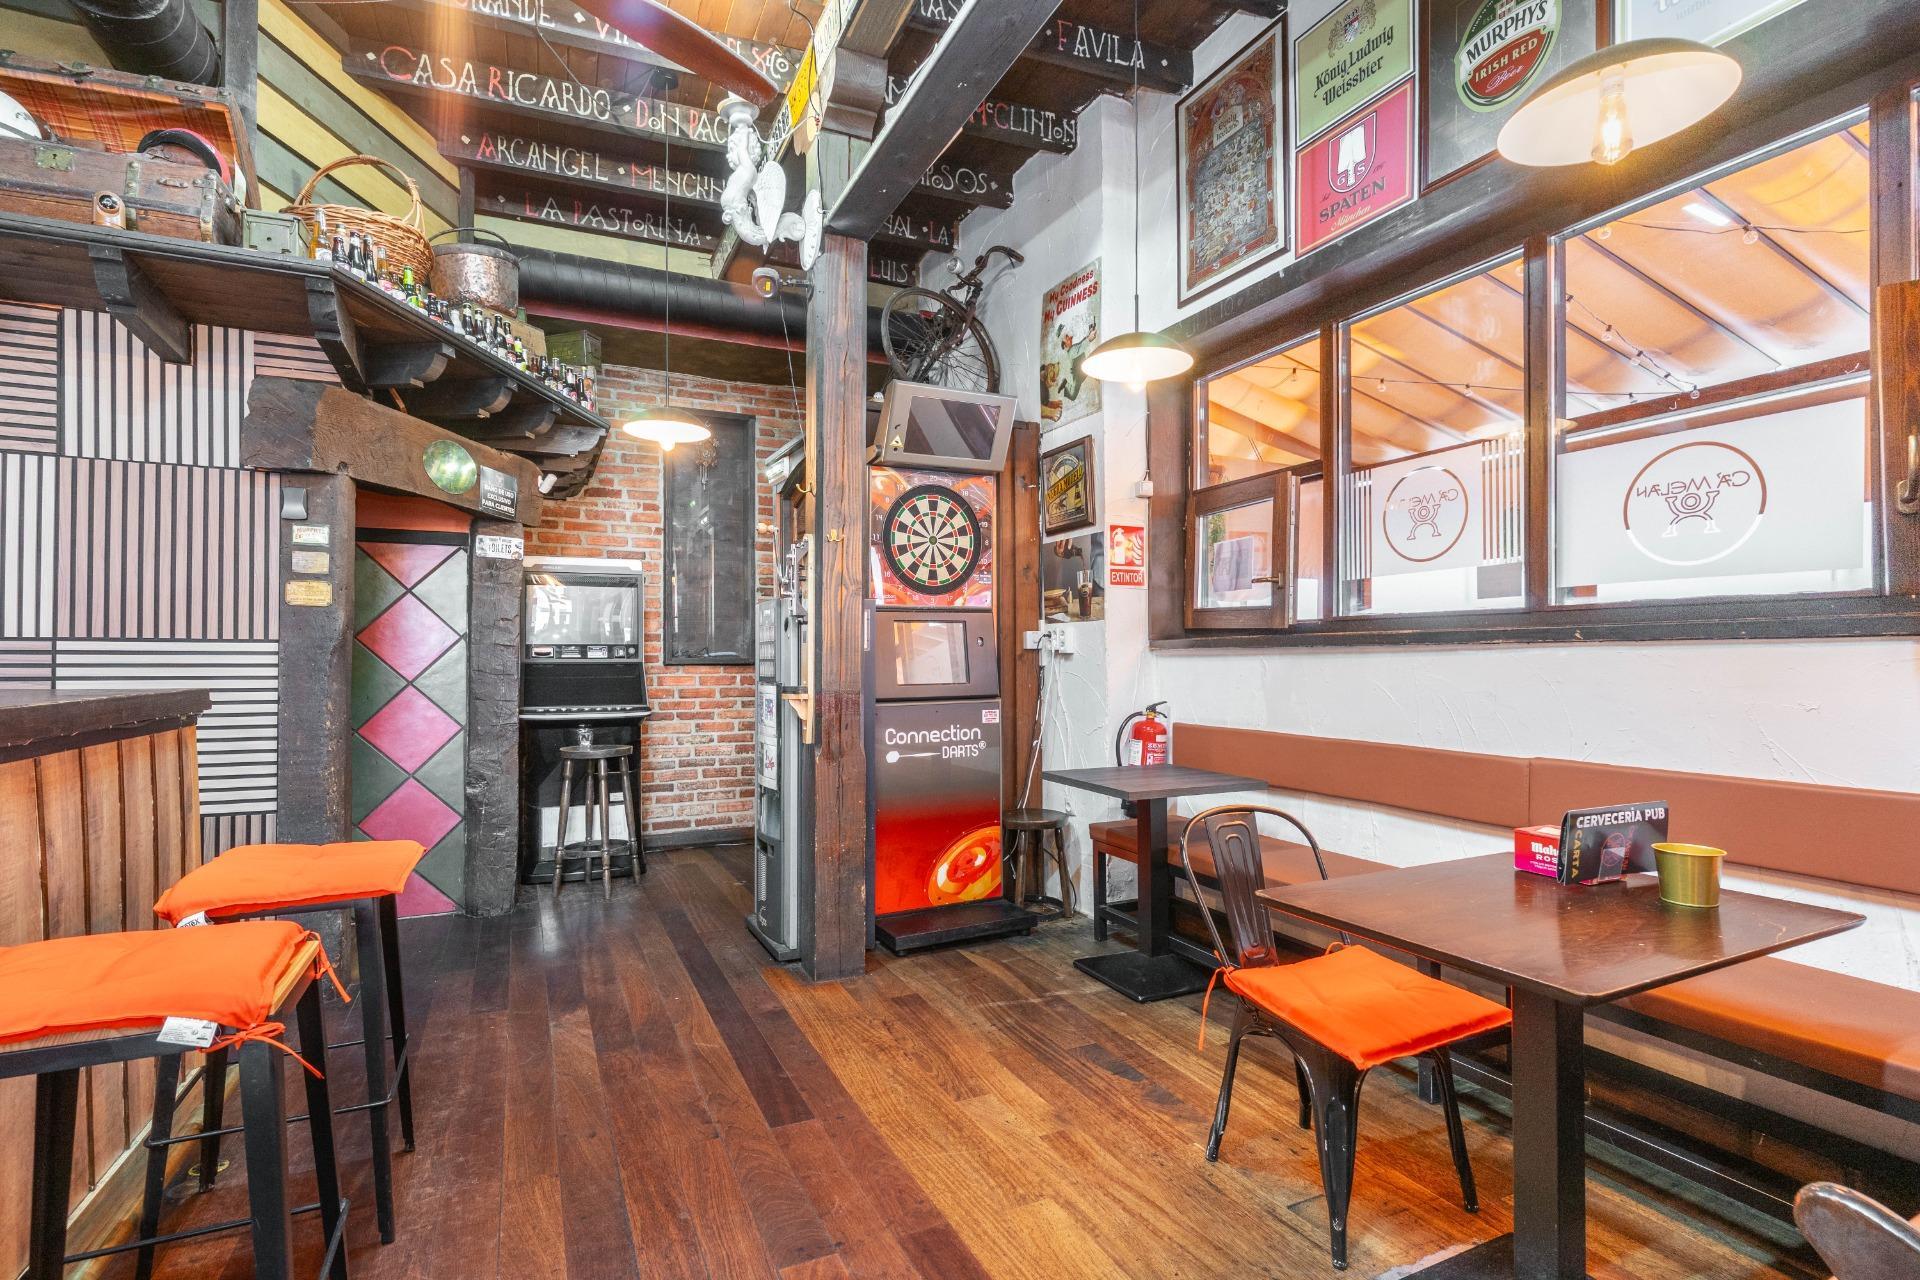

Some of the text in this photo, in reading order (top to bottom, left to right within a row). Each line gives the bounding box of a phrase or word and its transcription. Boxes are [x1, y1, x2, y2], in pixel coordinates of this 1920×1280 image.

[1056, 20, 1145, 70] FAVILA
[1313, 25, 1394, 98] König Ludwig
[1475, 37, 1539, 83] IRISH RED
[380, 46, 478, 95] CASA
[488, 66, 611, 120] RICARDO
[689, 110, 731, 144] PAC
[1322, 56, 1384, 106] Weissbier
[476, 133, 609, 181] ARCANGEL
[525, 191, 566, 222] LA
[1320, 176, 1386, 224] SPATEN
[1056, 281, 1098, 317] GUINNESS
[1060, 270, 1094, 298] Goodness
[1112, 571, 1143, 583] EXTINTOR
[885, 724, 981, 745] Connection
[1645, 807, 1665, 821] PUB
[1571, 830, 1583, 878] CARTA
